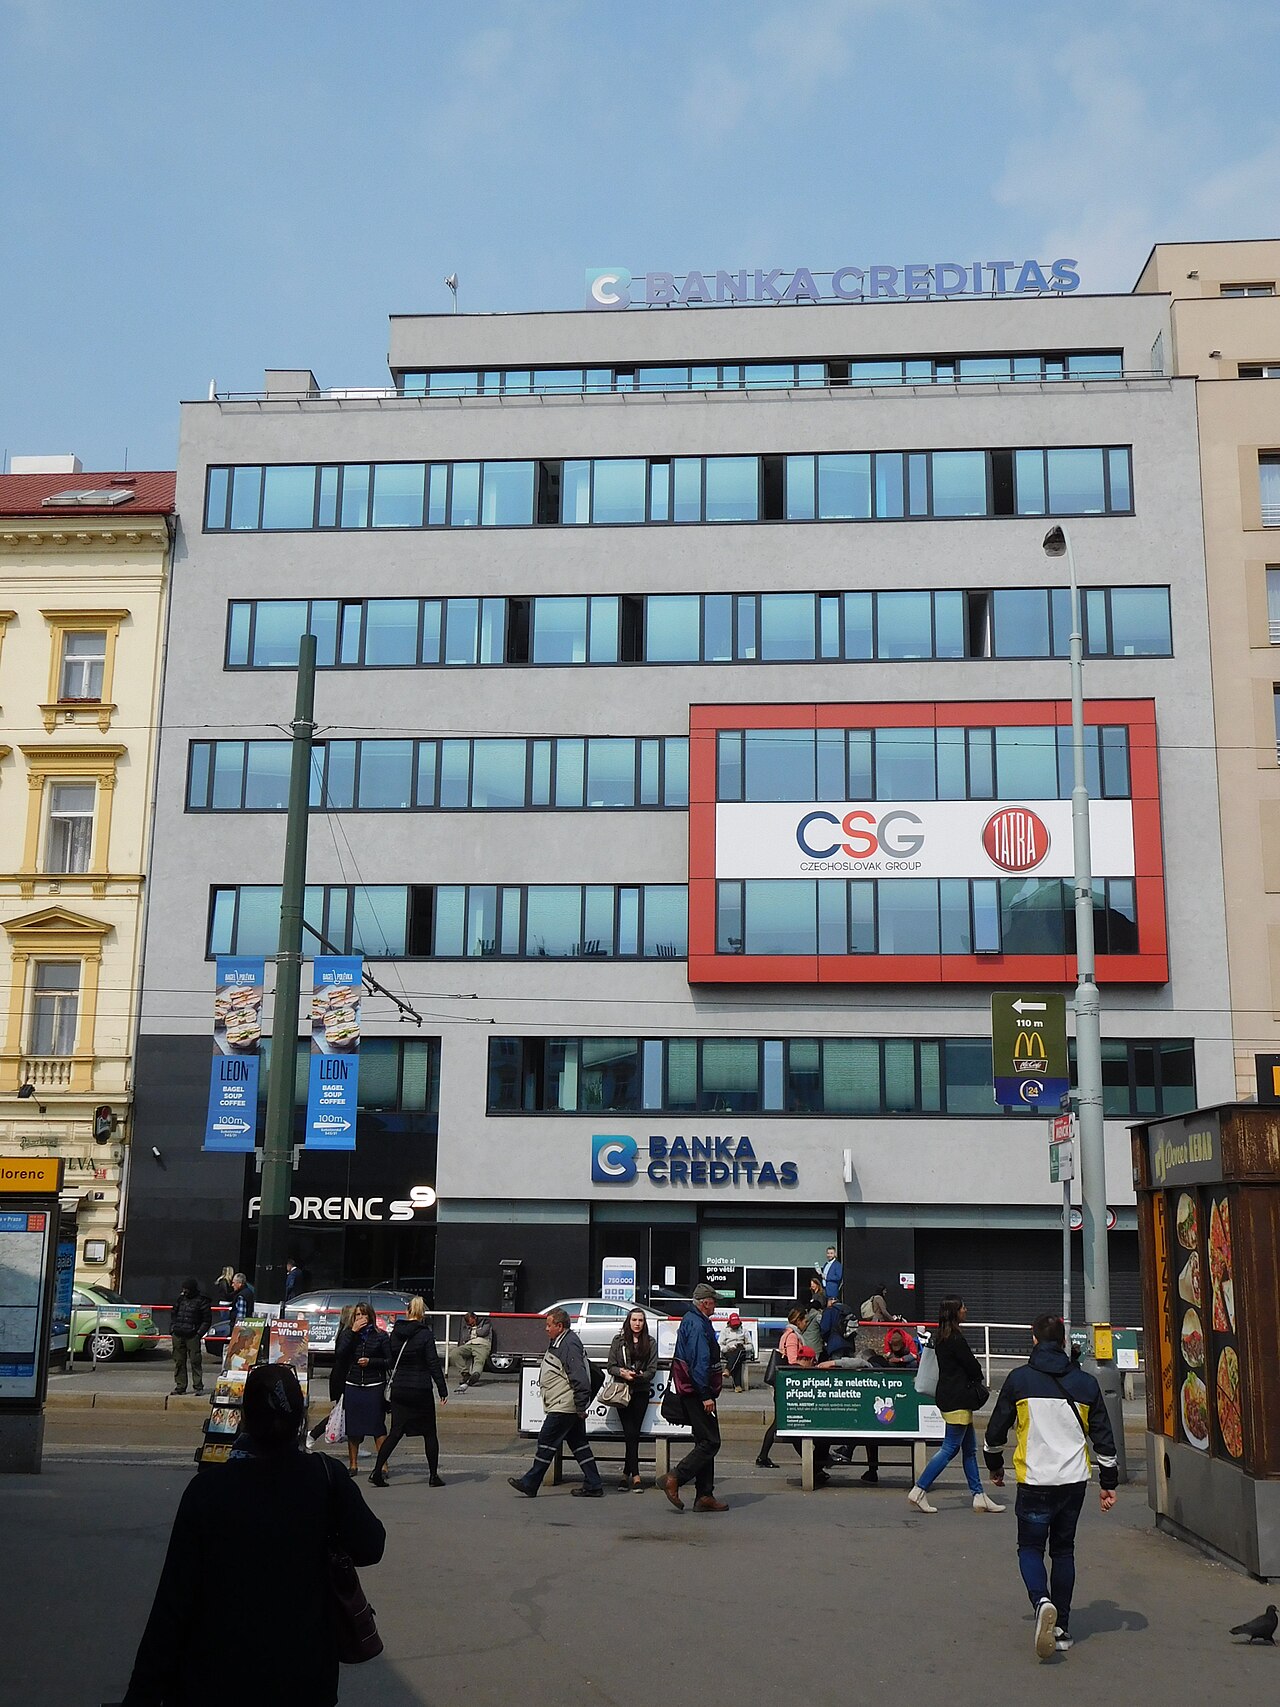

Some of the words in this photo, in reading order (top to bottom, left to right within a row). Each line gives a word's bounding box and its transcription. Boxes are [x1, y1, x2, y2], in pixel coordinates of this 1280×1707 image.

[646, 267, 820, 303] BANKA
[831, 258, 1081, 298] CREDITAS
[796, 810, 925, 859] CSG
[993, 812, 1037, 867] TATRA
[800, 861, 882, 871] CZECHOSLOVAK
[885, 861, 922, 871] GROUP
[1016, 1019, 1032, 1027] 110
[220, 1060, 249, 1081] LEON
[320, 1059, 348, 1080] LEON
[1028, 1086, 1039, 1095] 24
[218, 1116, 243, 1125] 100m
[318, 1114, 343, 1123] 100m
[649, 1135, 756, 1160] BANKA
[1188, 1131, 1213, 1162] KEBAB
[0, 1168, 45, 1179] lorenc
[647, 1160, 799, 1185] CREDITAS
[248, 1197, 383, 1220] FORENC
[706, 1274, 727, 1282] výnos
[271, 1320, 298, 1329] Peace
[785, 1377, 800, 1387] Pro
[802, 1377, 832, 1388] případ,
[834, 1378, 843, 1387] že
[845, 1378, 880, 1388] neletíte,
[888, 1379, 902, 1389] pro
[786, 1388, 816, 1399] případ,
[817, 1389, 827, 1398] že
[828, 1389, 861, 1398] naletíte
